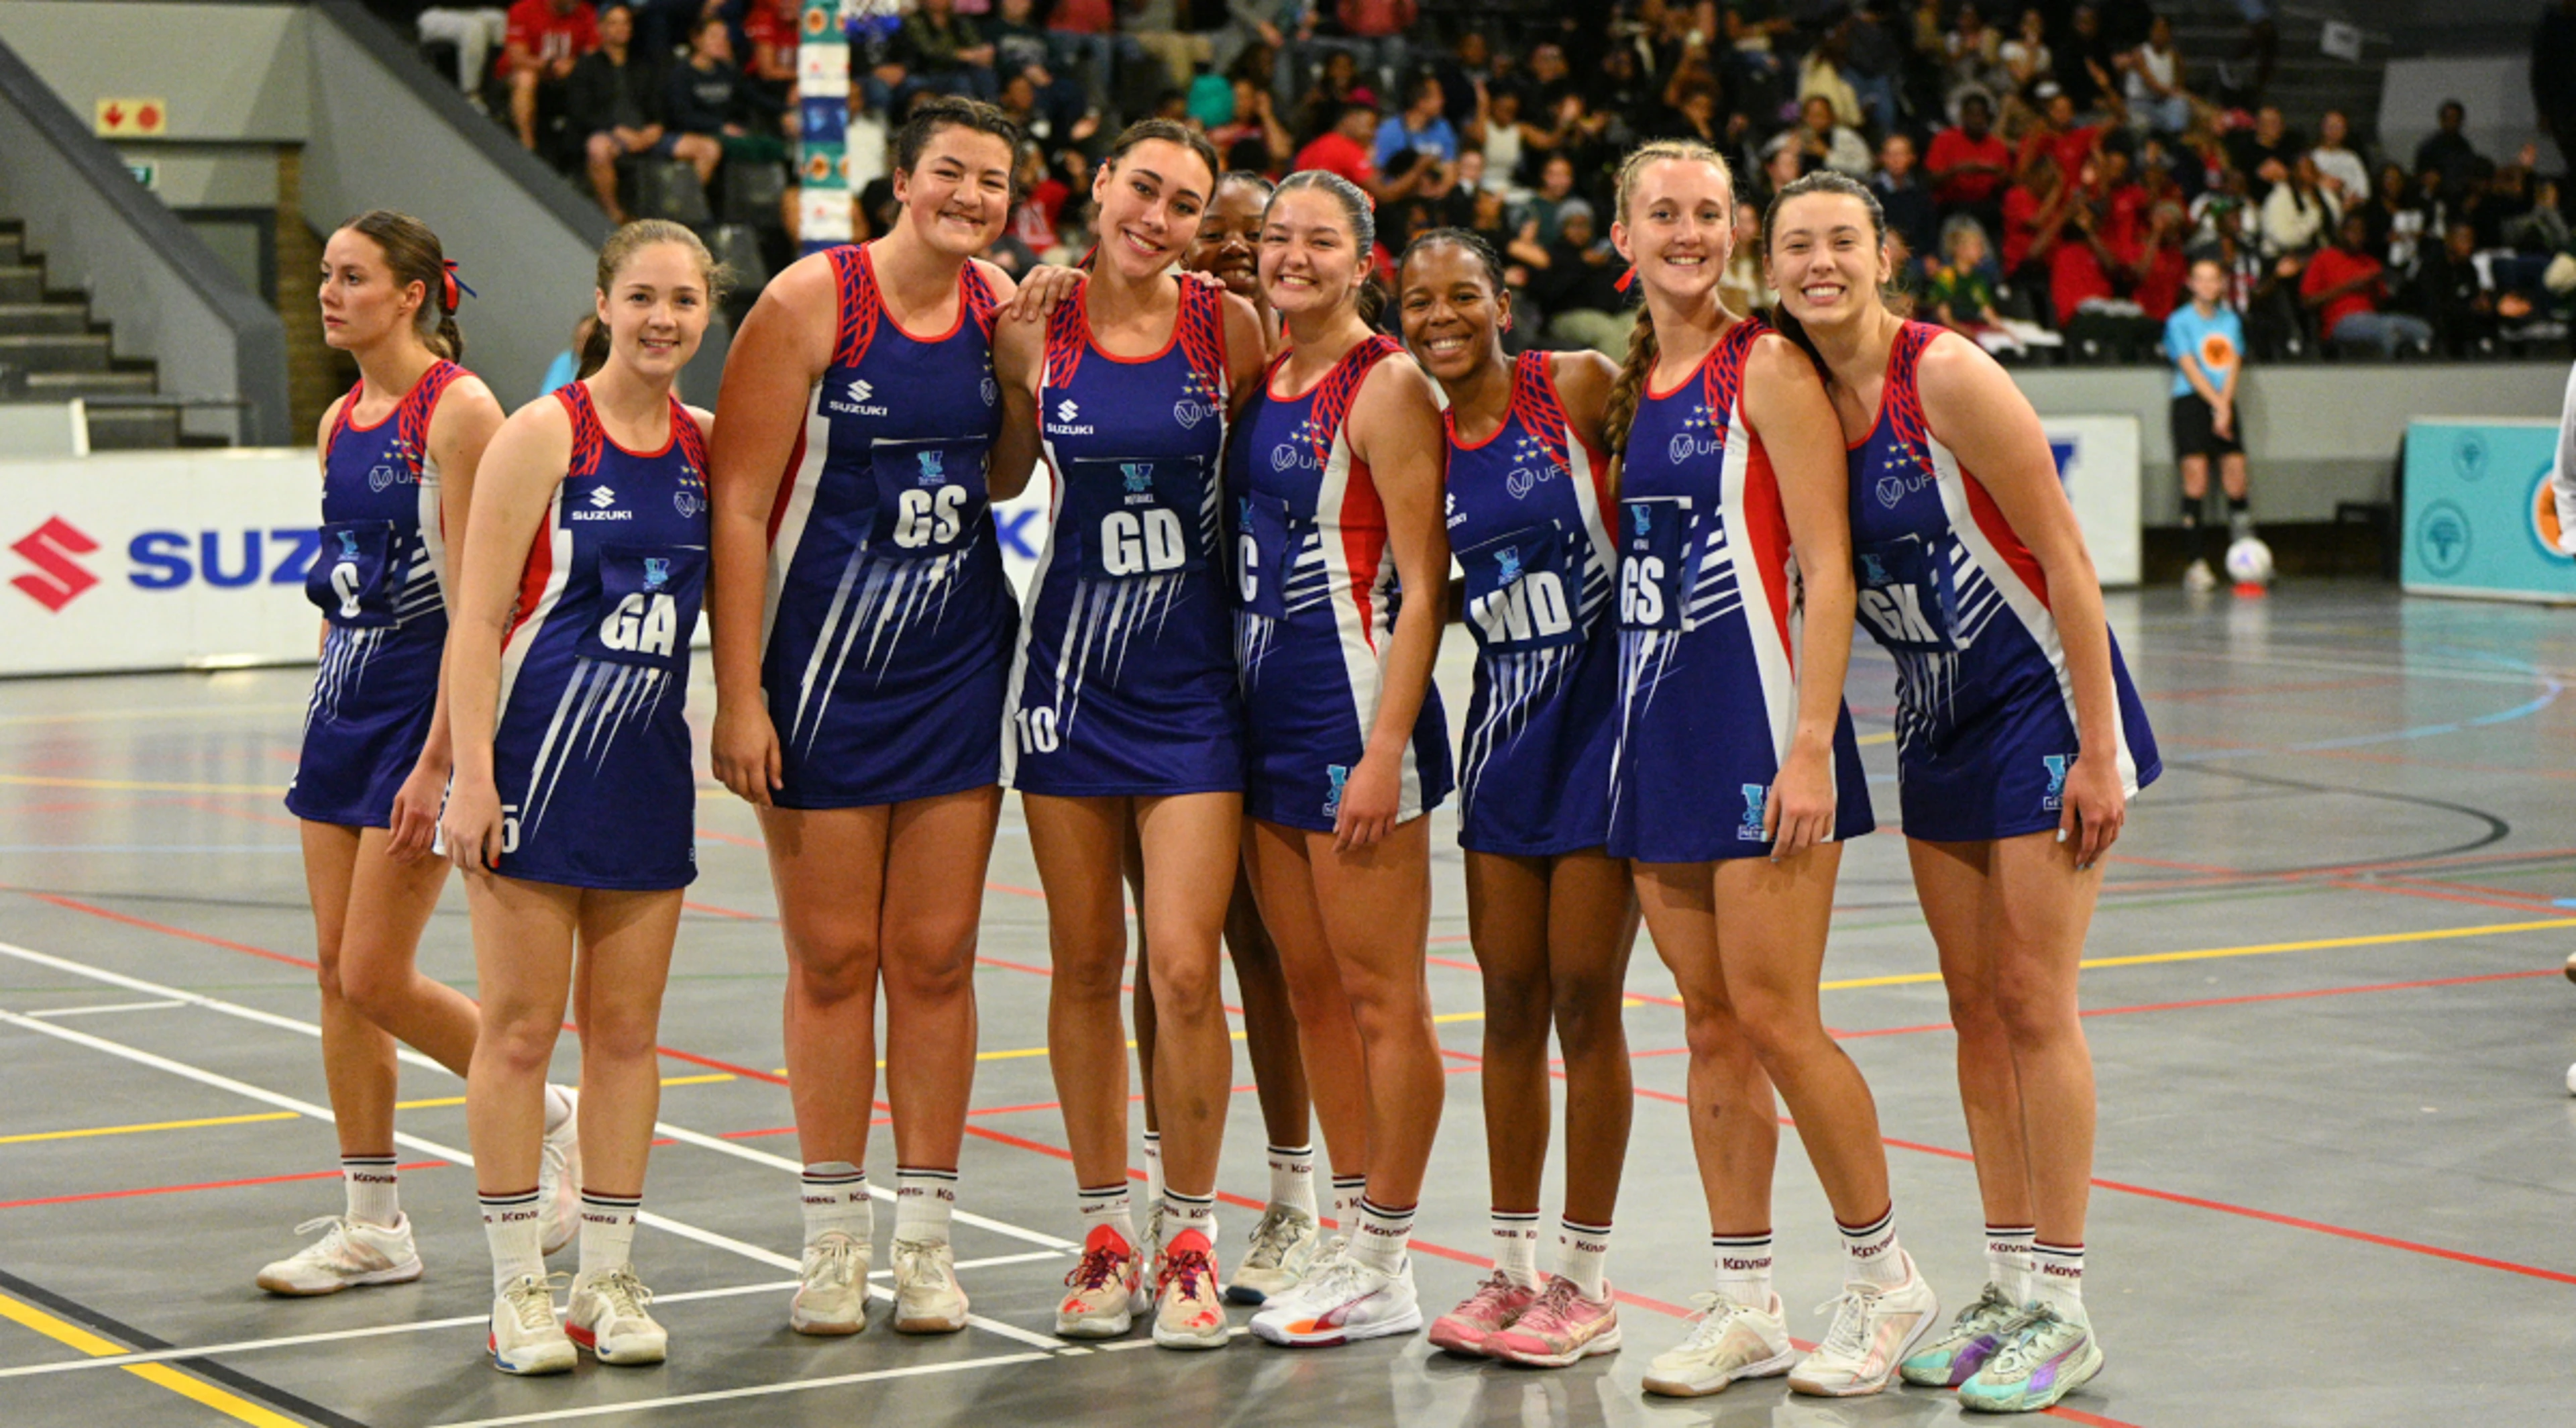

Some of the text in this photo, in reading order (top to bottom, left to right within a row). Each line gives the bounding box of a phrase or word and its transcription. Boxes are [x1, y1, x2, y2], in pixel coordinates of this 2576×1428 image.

[828, 401, 888, 416] SUZUKI
[1047, 423, 1093, 435] SUZUKI
[572, 511, 632, 520] SUZUKI
[893, 484, 967, 548] GS
[1101, 508, 1185, 576] GD
[127, 529, 321, 589] SUZ
[1470, 571, 1572, 644] WD
[1620, 556, 1664, 625] GS
[1859, 583, 1940, 642] GK
[600, 593, 676, 658] GA
[1015, 706, 1059, 754] 10
